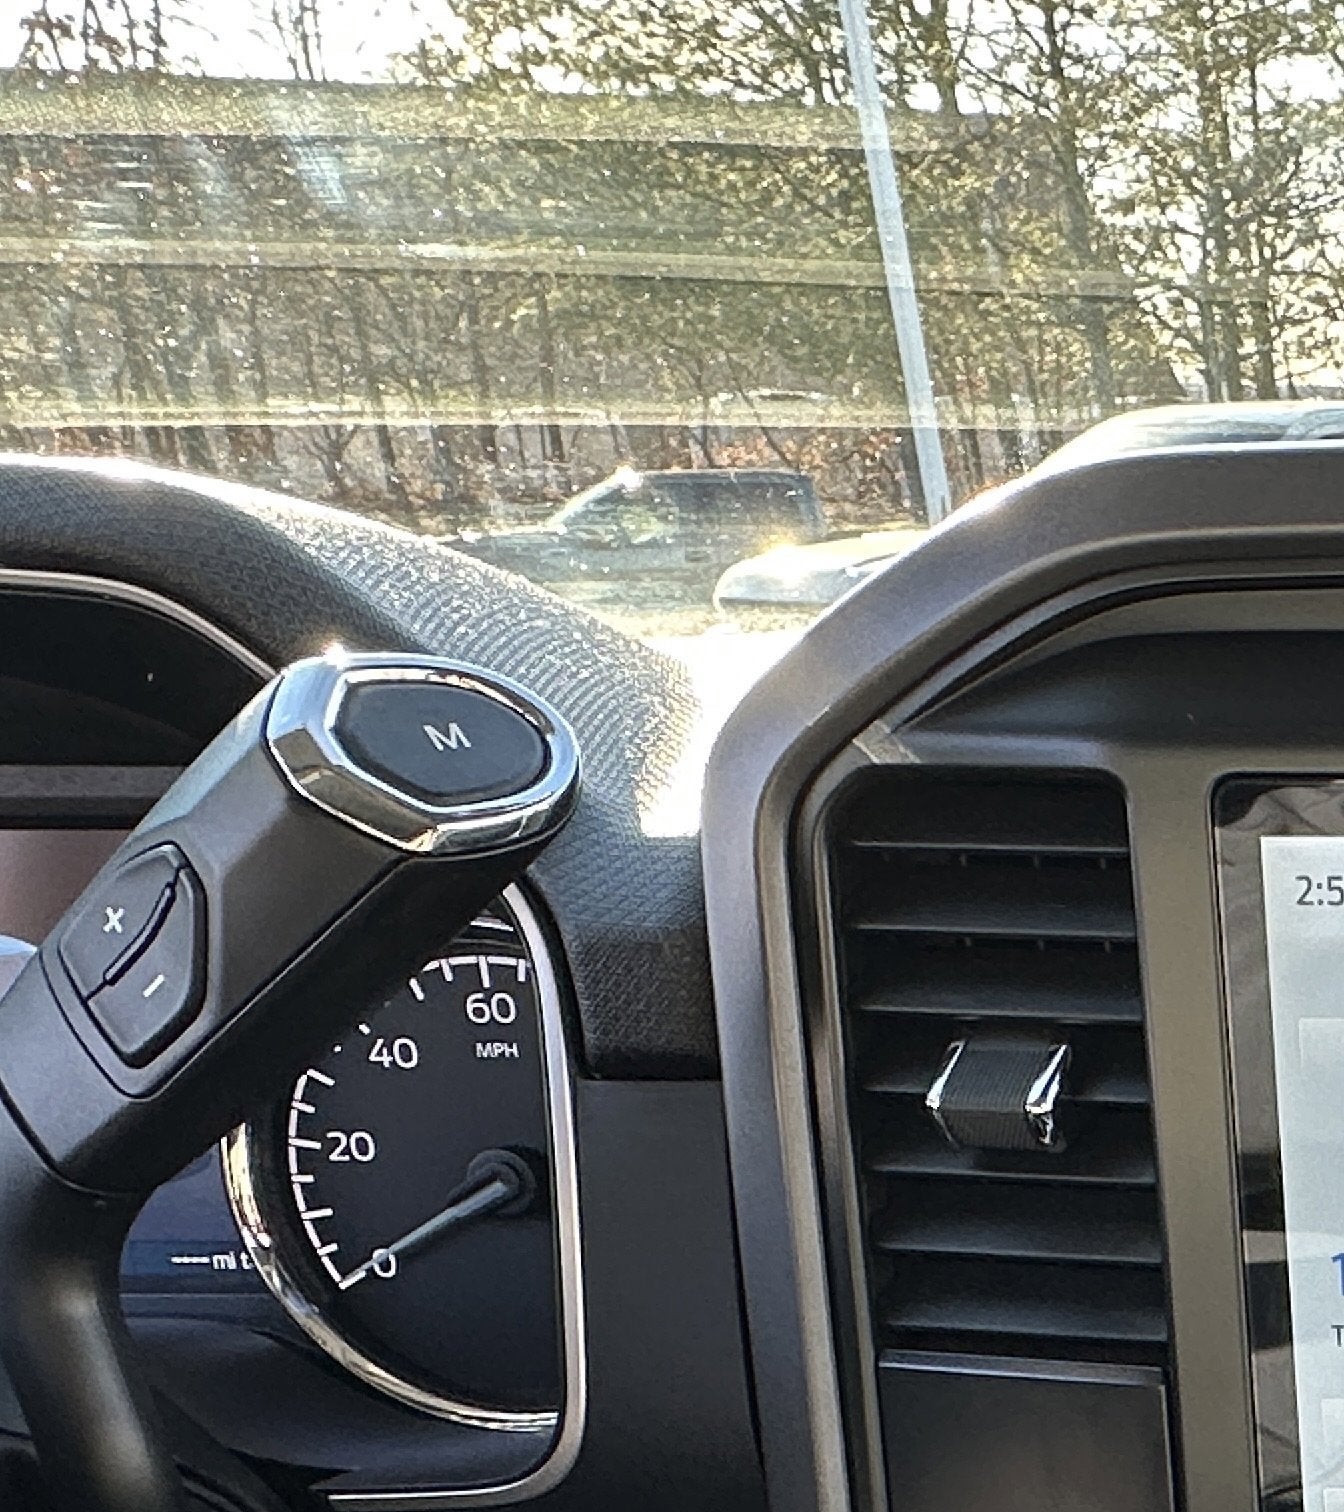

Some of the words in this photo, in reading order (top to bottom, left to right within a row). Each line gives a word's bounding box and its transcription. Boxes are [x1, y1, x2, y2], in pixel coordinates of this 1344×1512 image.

[466, 992, 516, 1024] 60
[367, 1038, 418, 1069] 40
[476, 1042, 520, 1058] MPH
[326, 1131, 376, 1162] 20
